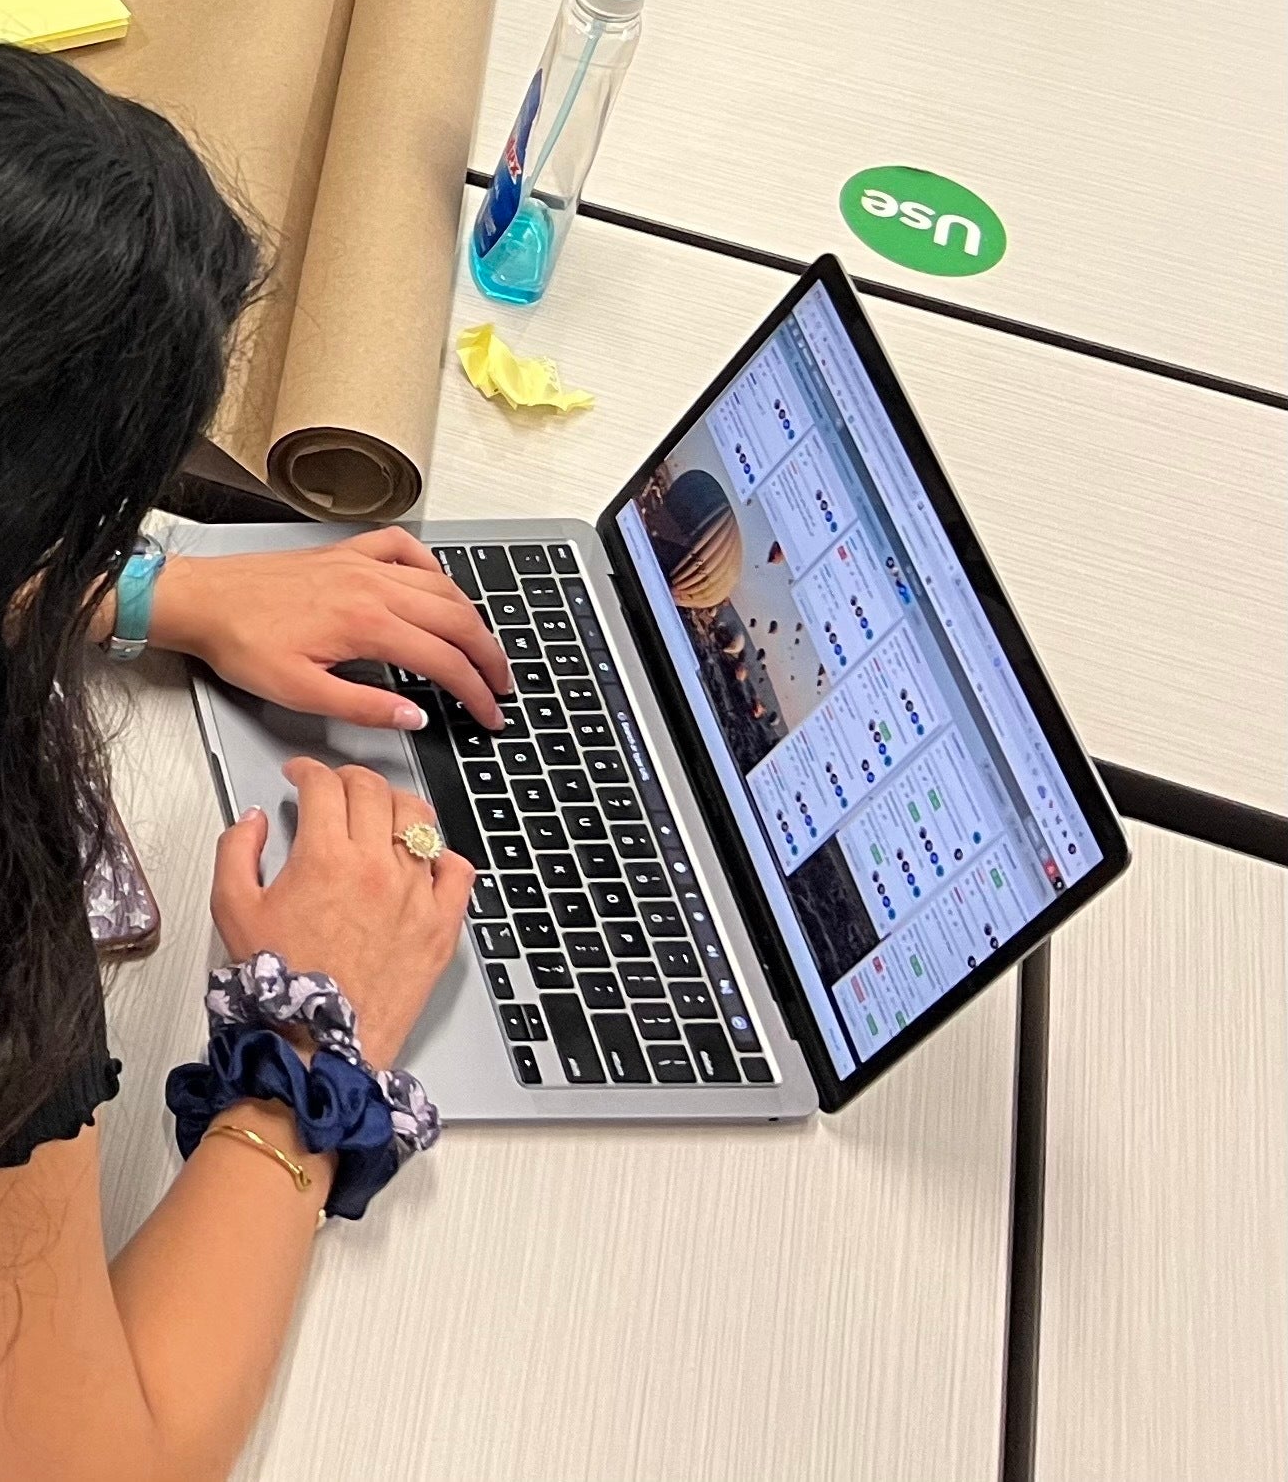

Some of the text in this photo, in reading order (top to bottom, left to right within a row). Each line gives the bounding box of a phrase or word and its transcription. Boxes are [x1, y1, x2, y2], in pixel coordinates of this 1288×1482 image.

[860, 188, 982, 258] Use
[515, 638, 528, 649] W
[527, 673, 540, 681] E
[468, 736, 480, 746] V
[552, 744, 565, 754] T
[566, 780, 579, 789] Y
[527, 790, 540, 800] H
[578, 818, 592, 827] U
[539, 828, 553, 837] J
[504, 846, 518, 858] M
[553, 866, 566, 875] K
[567, 905, 579, 913] L
[621, 933, 634, 943] P
